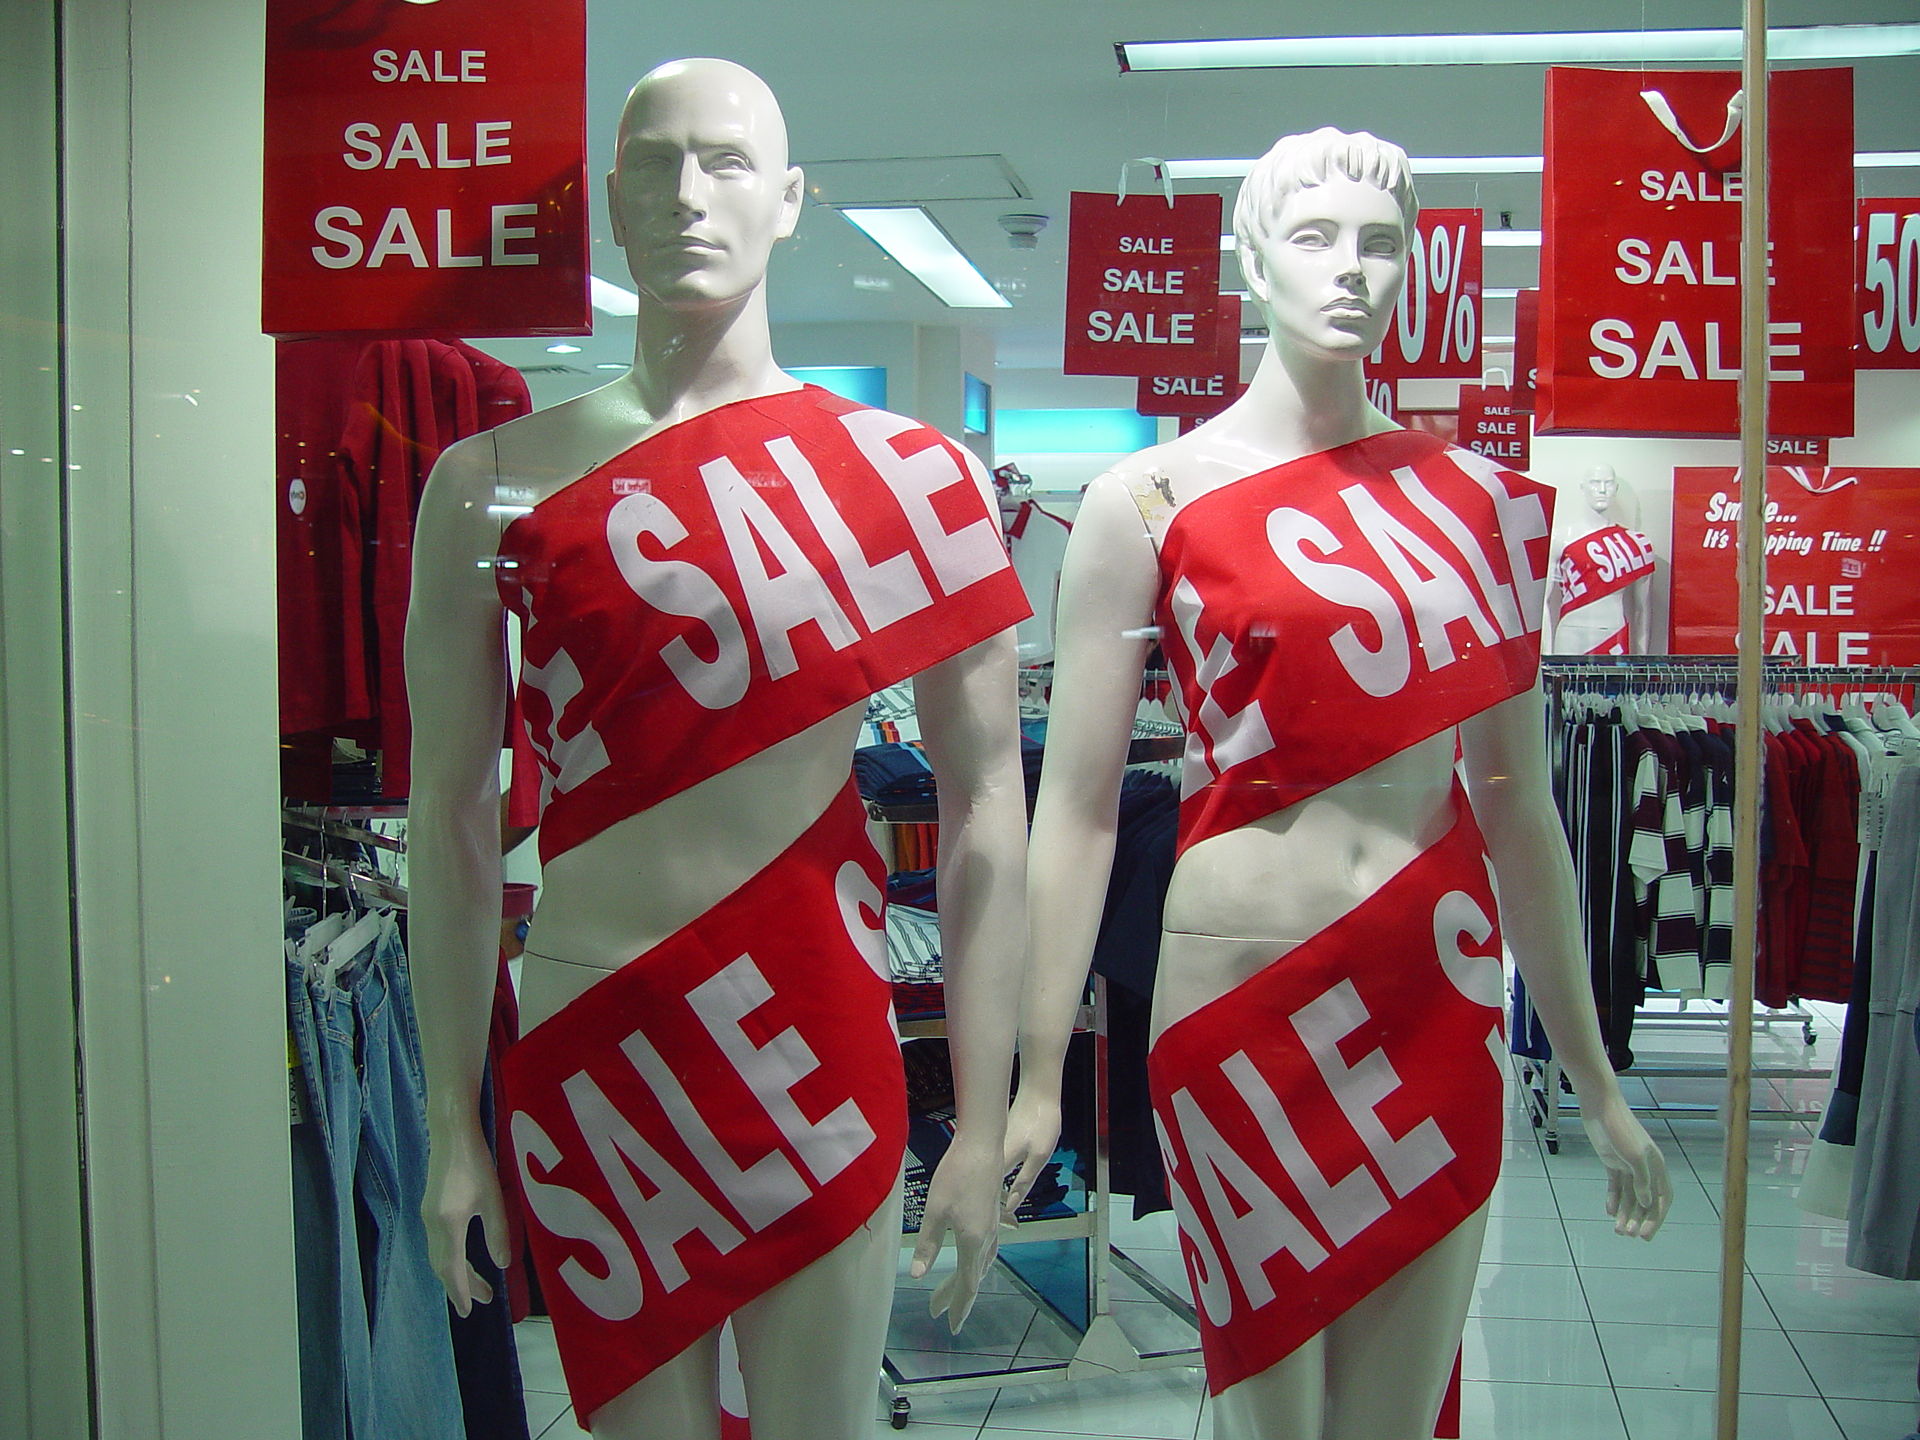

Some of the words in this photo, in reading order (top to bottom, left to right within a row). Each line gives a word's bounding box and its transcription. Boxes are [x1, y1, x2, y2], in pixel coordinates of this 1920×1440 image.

[372, 49, 486, 83] SALE
[343, 121, 512, 170] SALE
[1640, 170, 1743, 202] SALE
[311, 204, 539, 269] SALE
[1118, 236, 1174, 255] SALE
[1103, 268, 1184, 294] SALE
[1371, 225, 1475, 363] 0%
[1087, 310, 1195, 344] SALE
[1588, 319, 1805, 381] SALE
[1152, 375, 1223, 396] SALE
[1477, 421, 1516, 435] SALE
[1484, 406, 1511, 416] SALE
[1470, 440, 1521, 457] SALE
[1766, 440, 1818, 455] SALE
[1704, 491, 1797, 523] Sme...
[1586, 529, 1655, 583] SALE
[1703, 528, 1729, 549] It's
[1821, 530, 1861, 552] Time
[606, 408, 1010, 709] SALE
[1266, 449, 1549, 698] SALE
[1734, 630, 1871, 668] ALE
[511, 951, 877, 1321] SALE
[1152, 977, 1456, 1328] SALE
